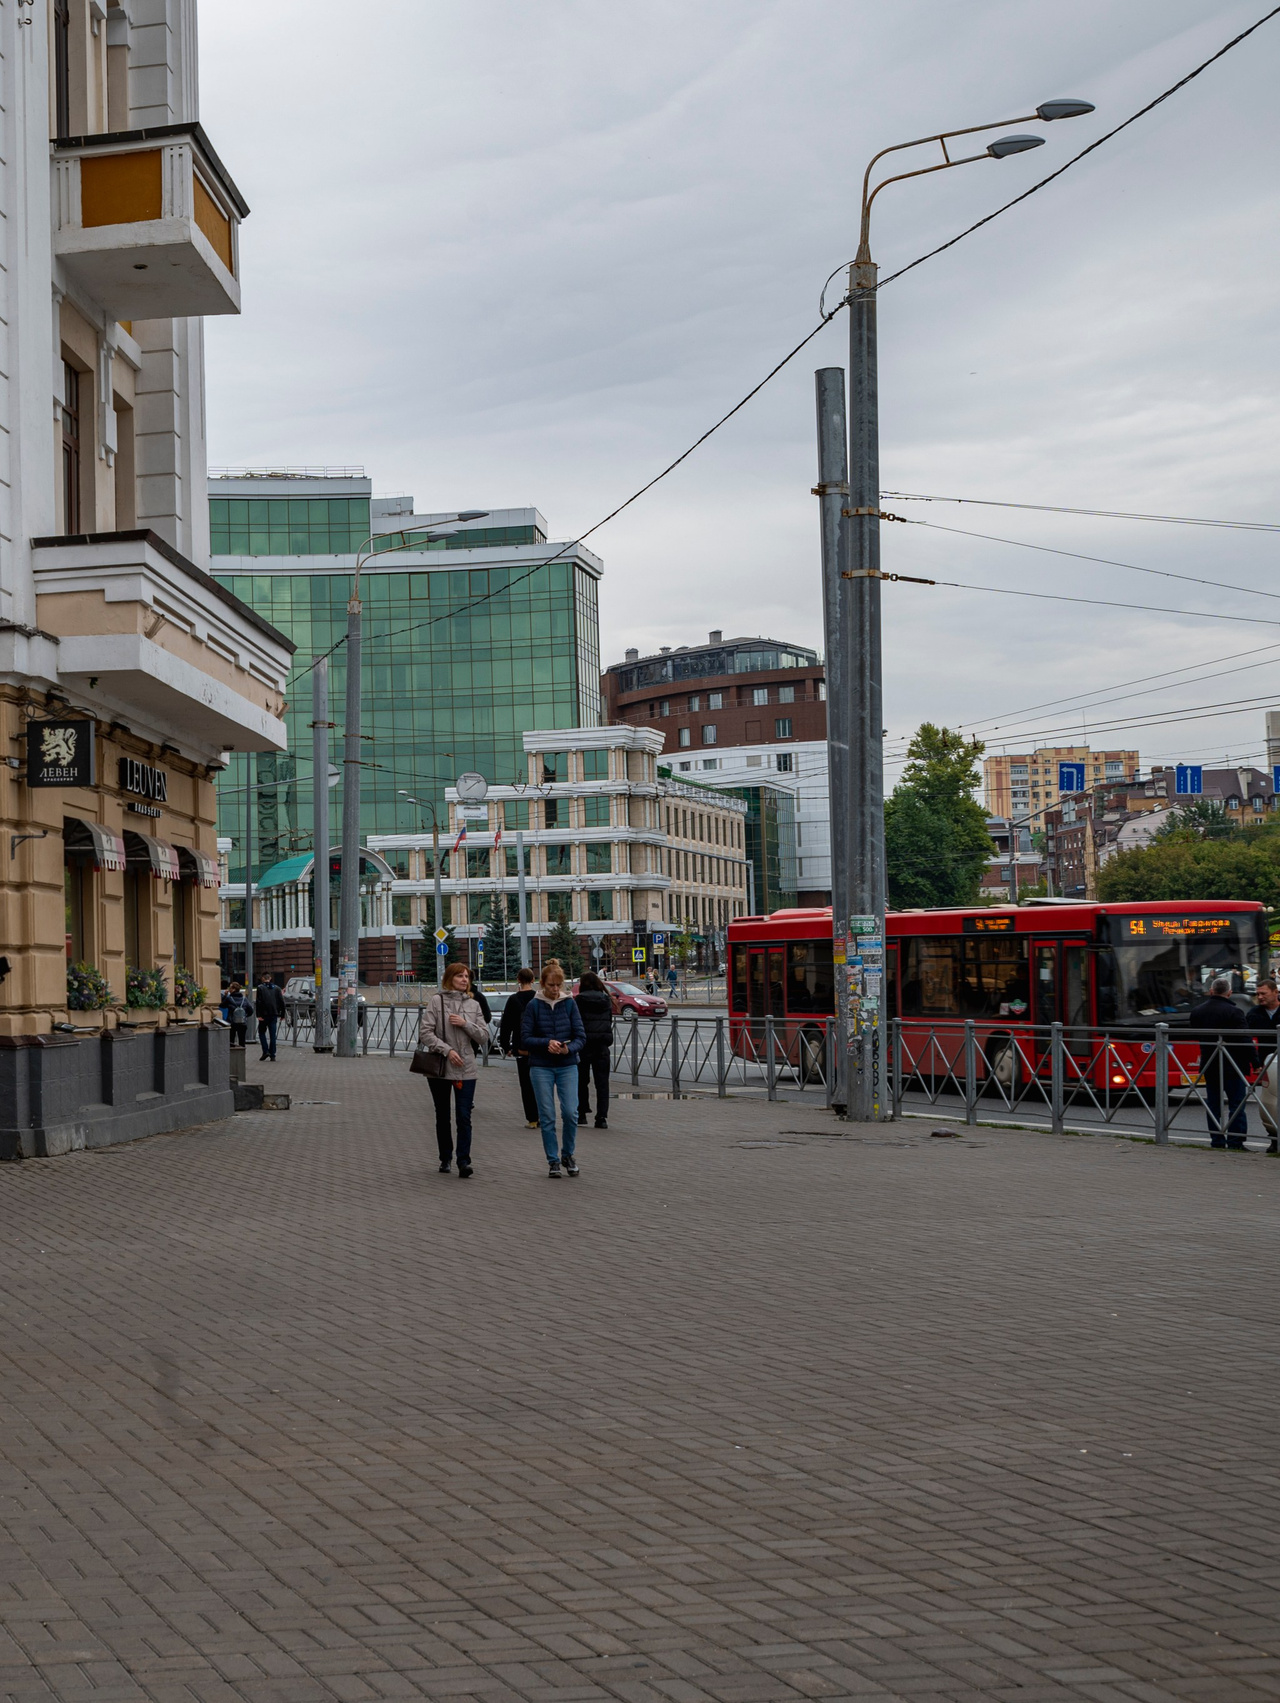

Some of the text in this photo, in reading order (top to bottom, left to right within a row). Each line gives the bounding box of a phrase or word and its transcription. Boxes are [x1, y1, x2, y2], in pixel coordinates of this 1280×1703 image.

[40, 767, 78, 777] ЛЕВЕН
[125, 757, 168, 801] LEUVEN
[655, 934, 662, 943] P
